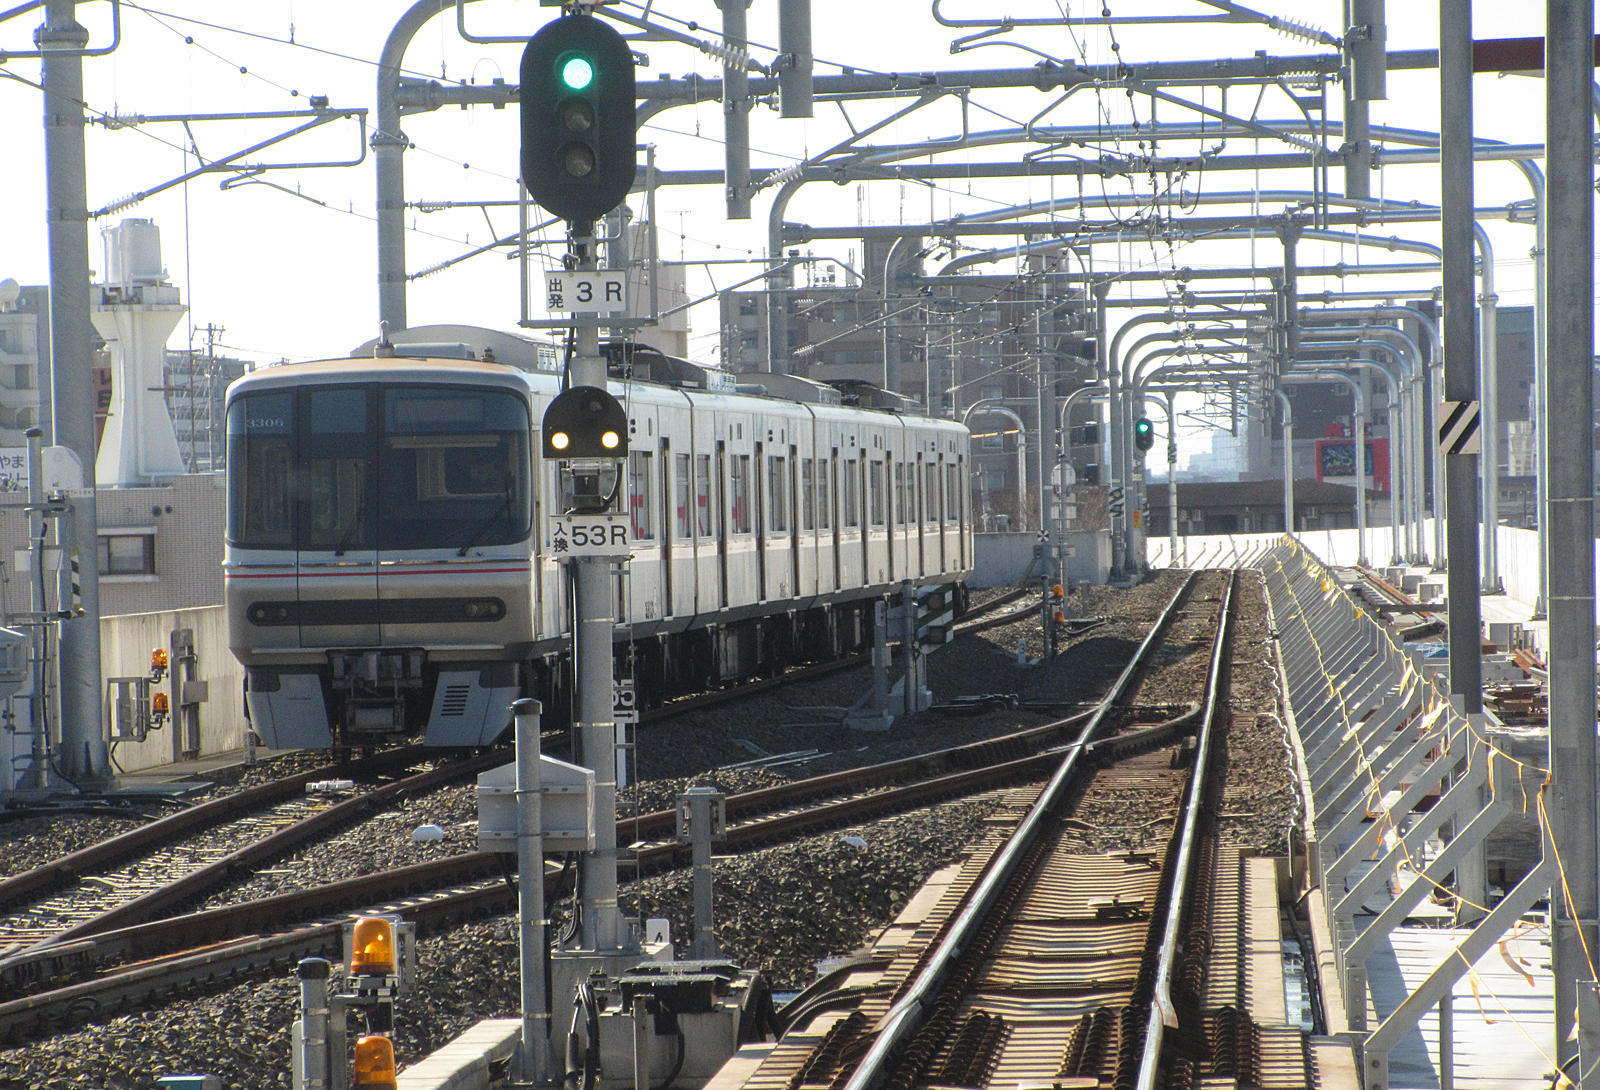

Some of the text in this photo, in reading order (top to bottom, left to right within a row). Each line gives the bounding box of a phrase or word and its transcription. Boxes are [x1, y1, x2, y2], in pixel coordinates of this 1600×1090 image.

[548, 277, 564, 309] 出発
[576, 281, 622, 303] 3 R
[246, 418, 284, 428] 3306
[553, 522, 570, 553] 入換
[572, 525, 628, 547] 53R
[1019, 643, 1026, 655] 3
